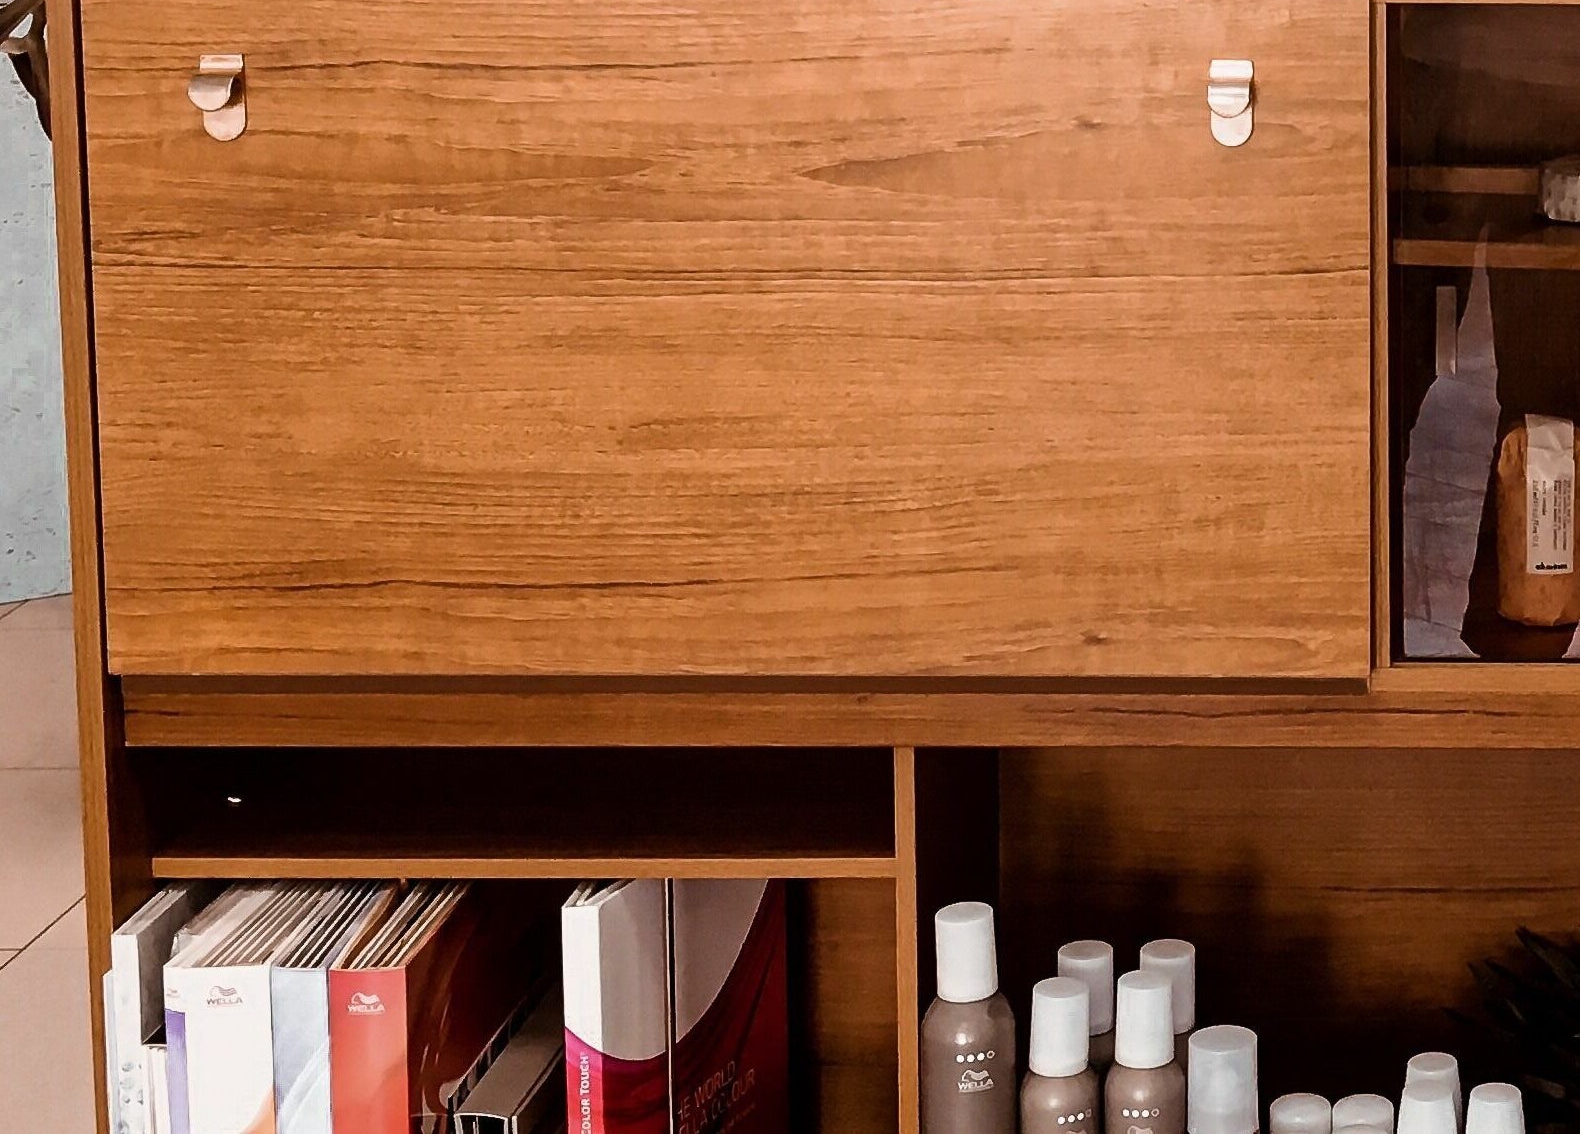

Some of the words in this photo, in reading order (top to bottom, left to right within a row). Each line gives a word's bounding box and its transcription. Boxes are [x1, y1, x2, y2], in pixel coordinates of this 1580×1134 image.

[207, 997, 243, 1005] WELLA
[347, 1003, 386, 1013] WELLA
[580, 1055, 590, 1096] TOUCH
[957, 1078, 994, 1090] WELLA
